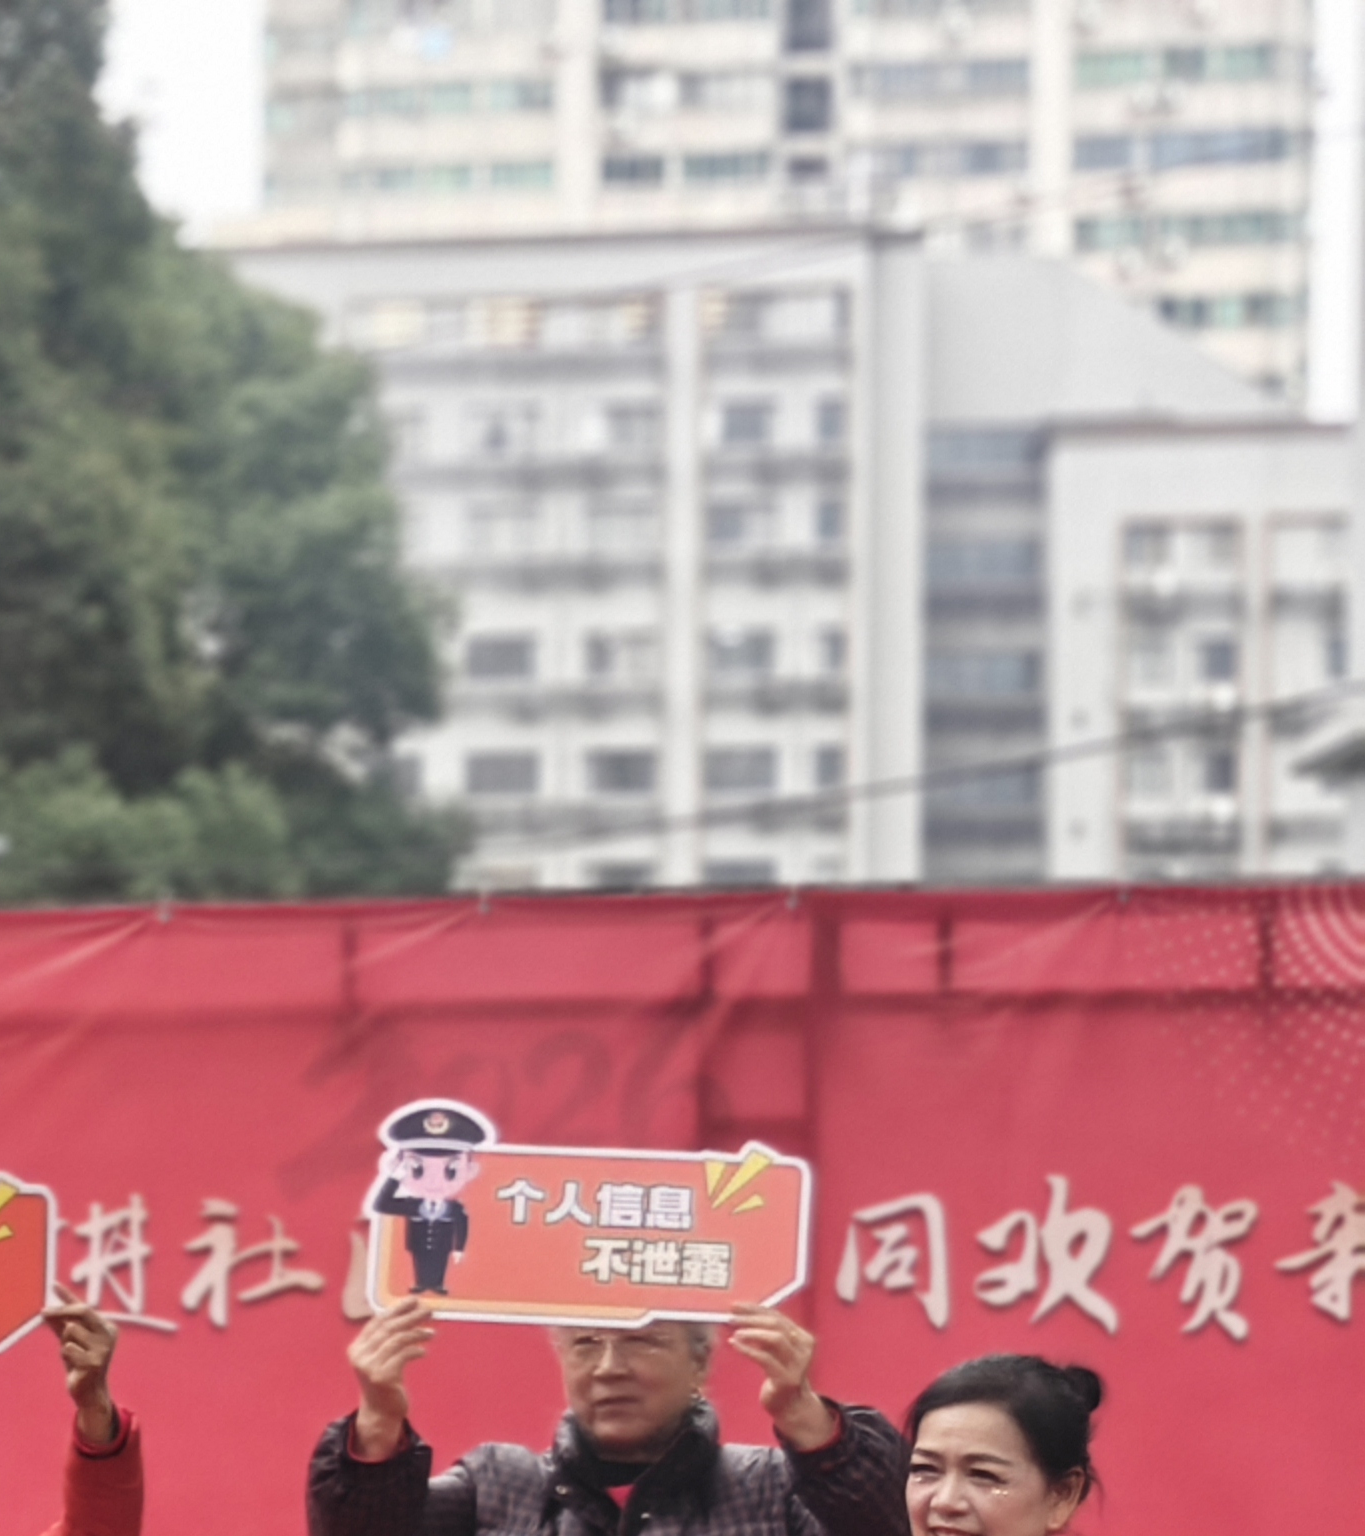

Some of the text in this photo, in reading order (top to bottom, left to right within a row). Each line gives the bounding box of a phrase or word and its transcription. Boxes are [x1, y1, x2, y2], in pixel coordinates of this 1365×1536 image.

[497, 1179, 694, 1230] 个人信息
[580, 1238, 732, 1289] 不泄露
